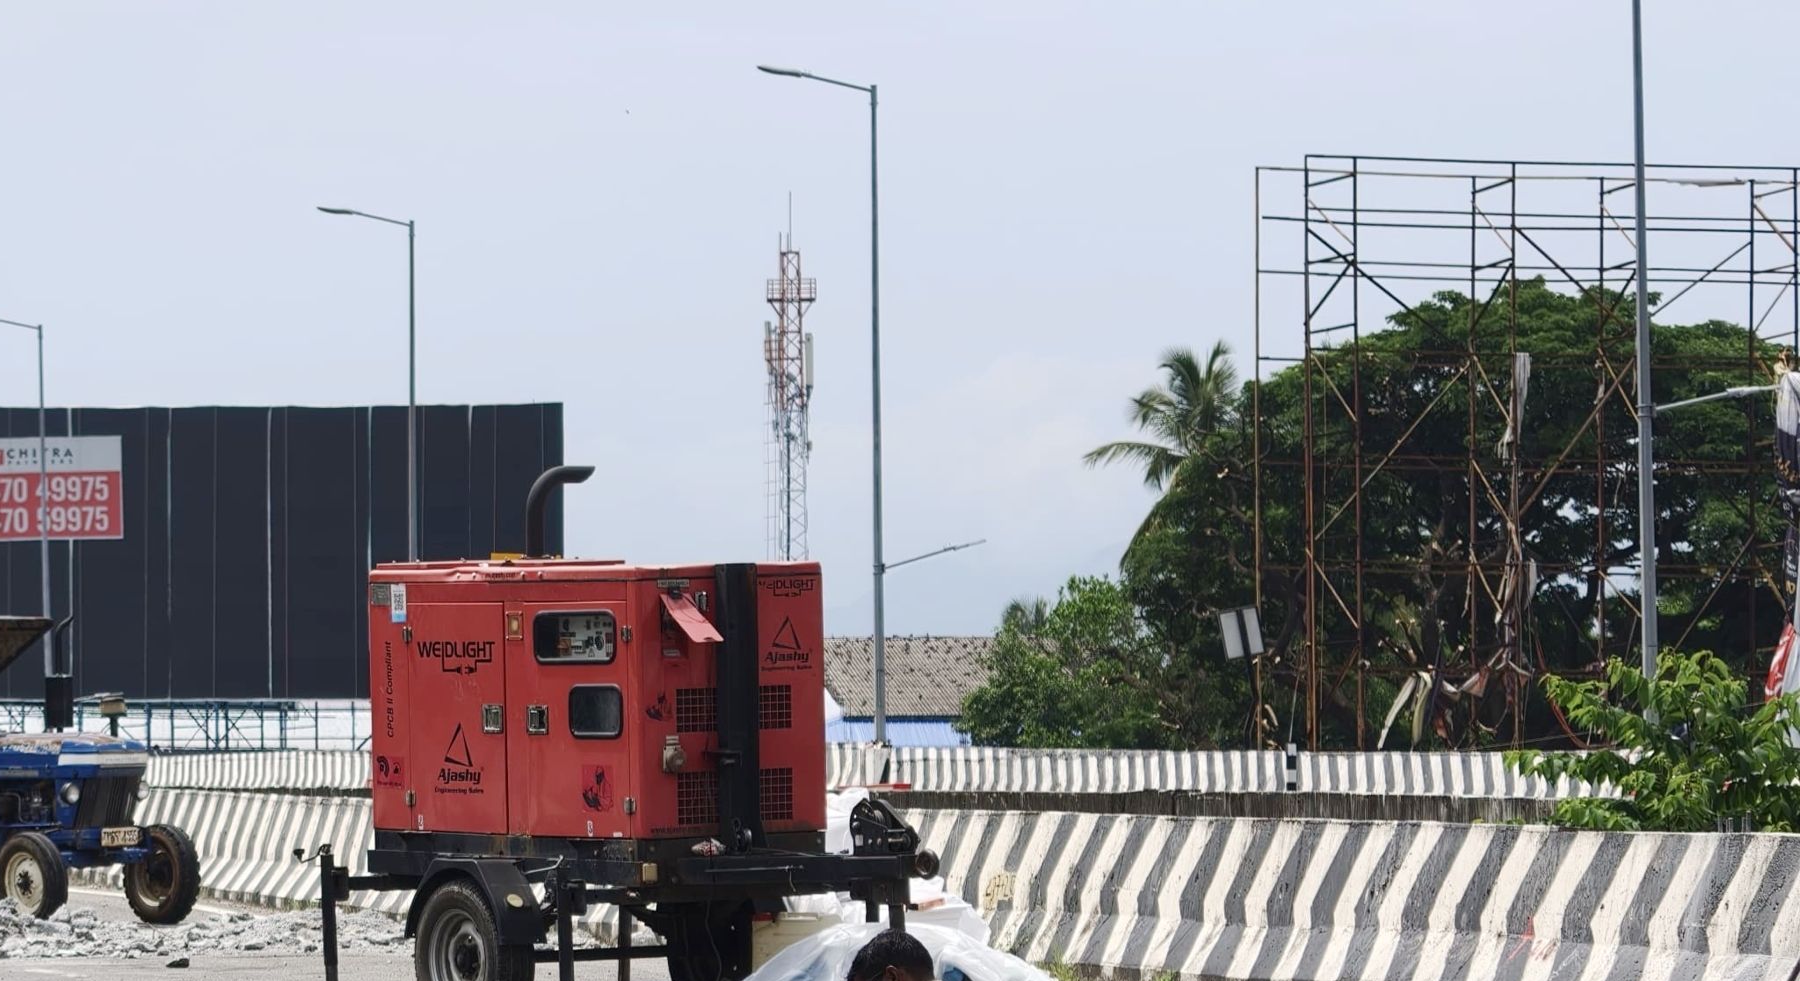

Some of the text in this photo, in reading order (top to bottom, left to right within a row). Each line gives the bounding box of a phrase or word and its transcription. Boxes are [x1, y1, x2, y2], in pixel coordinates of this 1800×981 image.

[36, 475, 109, 502] 49975
[37, 505, 109, 532] 59975
[385, 641, 394, 695] Compliant
[765, 652, 809, 664] Ajashy
[438, 768, 481, 784] Ajashy
